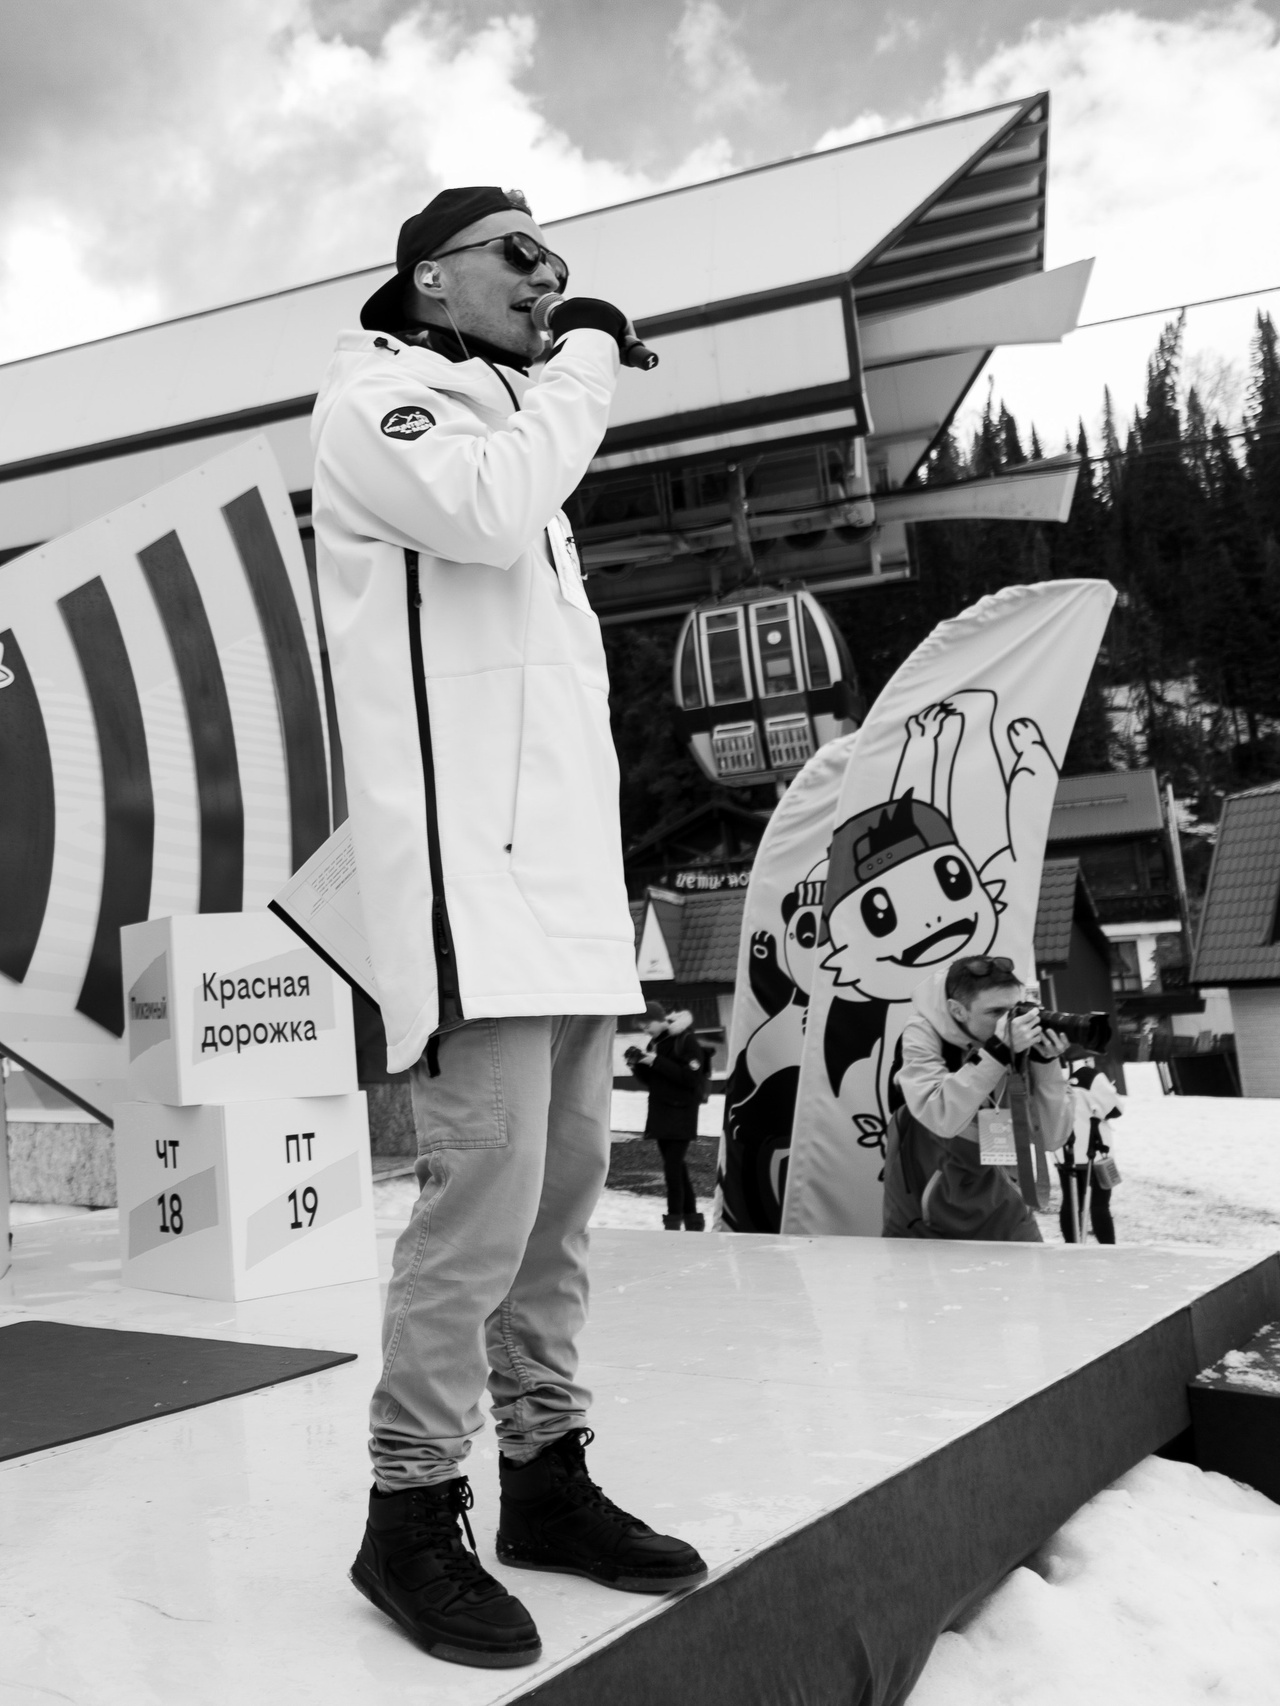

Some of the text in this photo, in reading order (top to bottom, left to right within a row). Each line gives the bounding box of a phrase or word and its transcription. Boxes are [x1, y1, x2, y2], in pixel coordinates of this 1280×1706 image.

[202, 972, 310, 1009] Красная
[201, 1019, 317, 1054] дорожка
[157, 1193, 184, 1235] 18
[287, 1186, 319, 1230] 19
